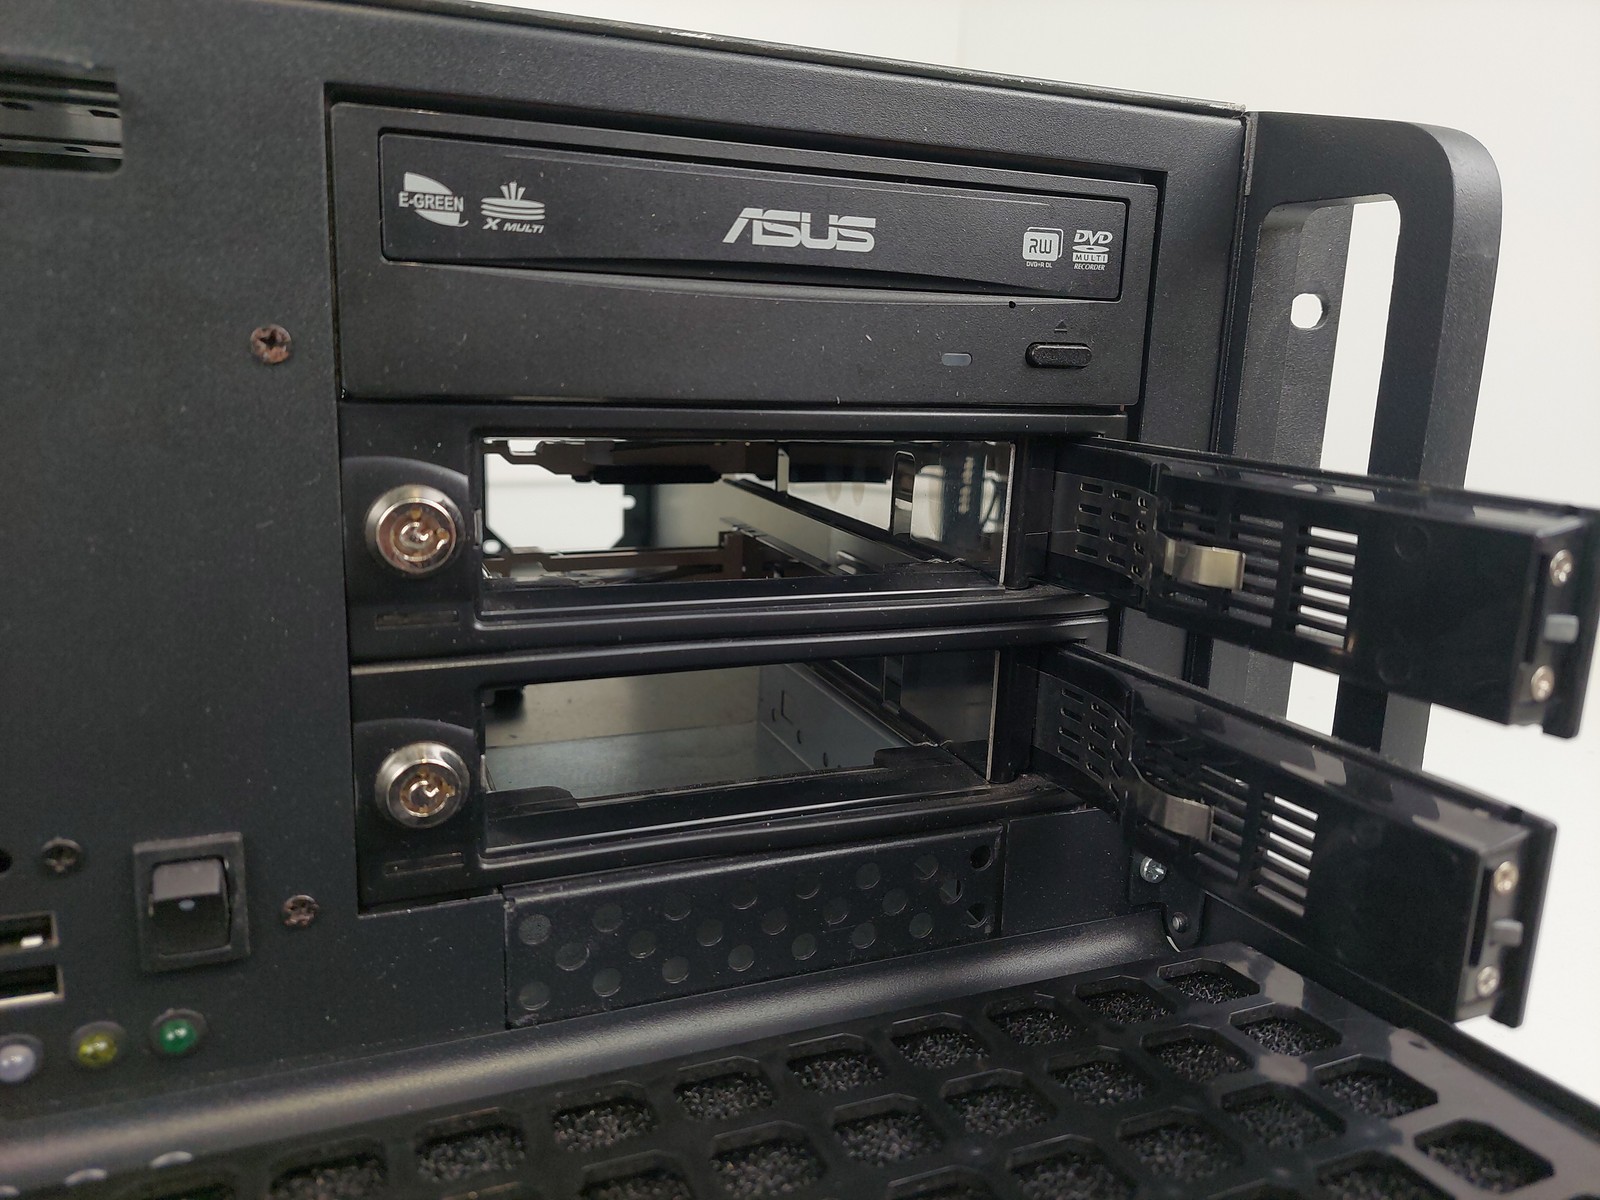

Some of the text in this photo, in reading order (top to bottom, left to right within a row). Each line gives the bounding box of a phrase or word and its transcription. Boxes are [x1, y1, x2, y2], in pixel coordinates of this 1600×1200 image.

[398, 190, 465, 213] E-GREEN
[481, 216, 545, 234] X MULTI
[722, 207, 876, 253] ASUS
[1073, 229, 1113, 246] DVD
[1028, 238, 1053, 255] RW
[1074, 253, 1106, 262] MULTI
[1073, 263, 1106, 271] RECORDER
